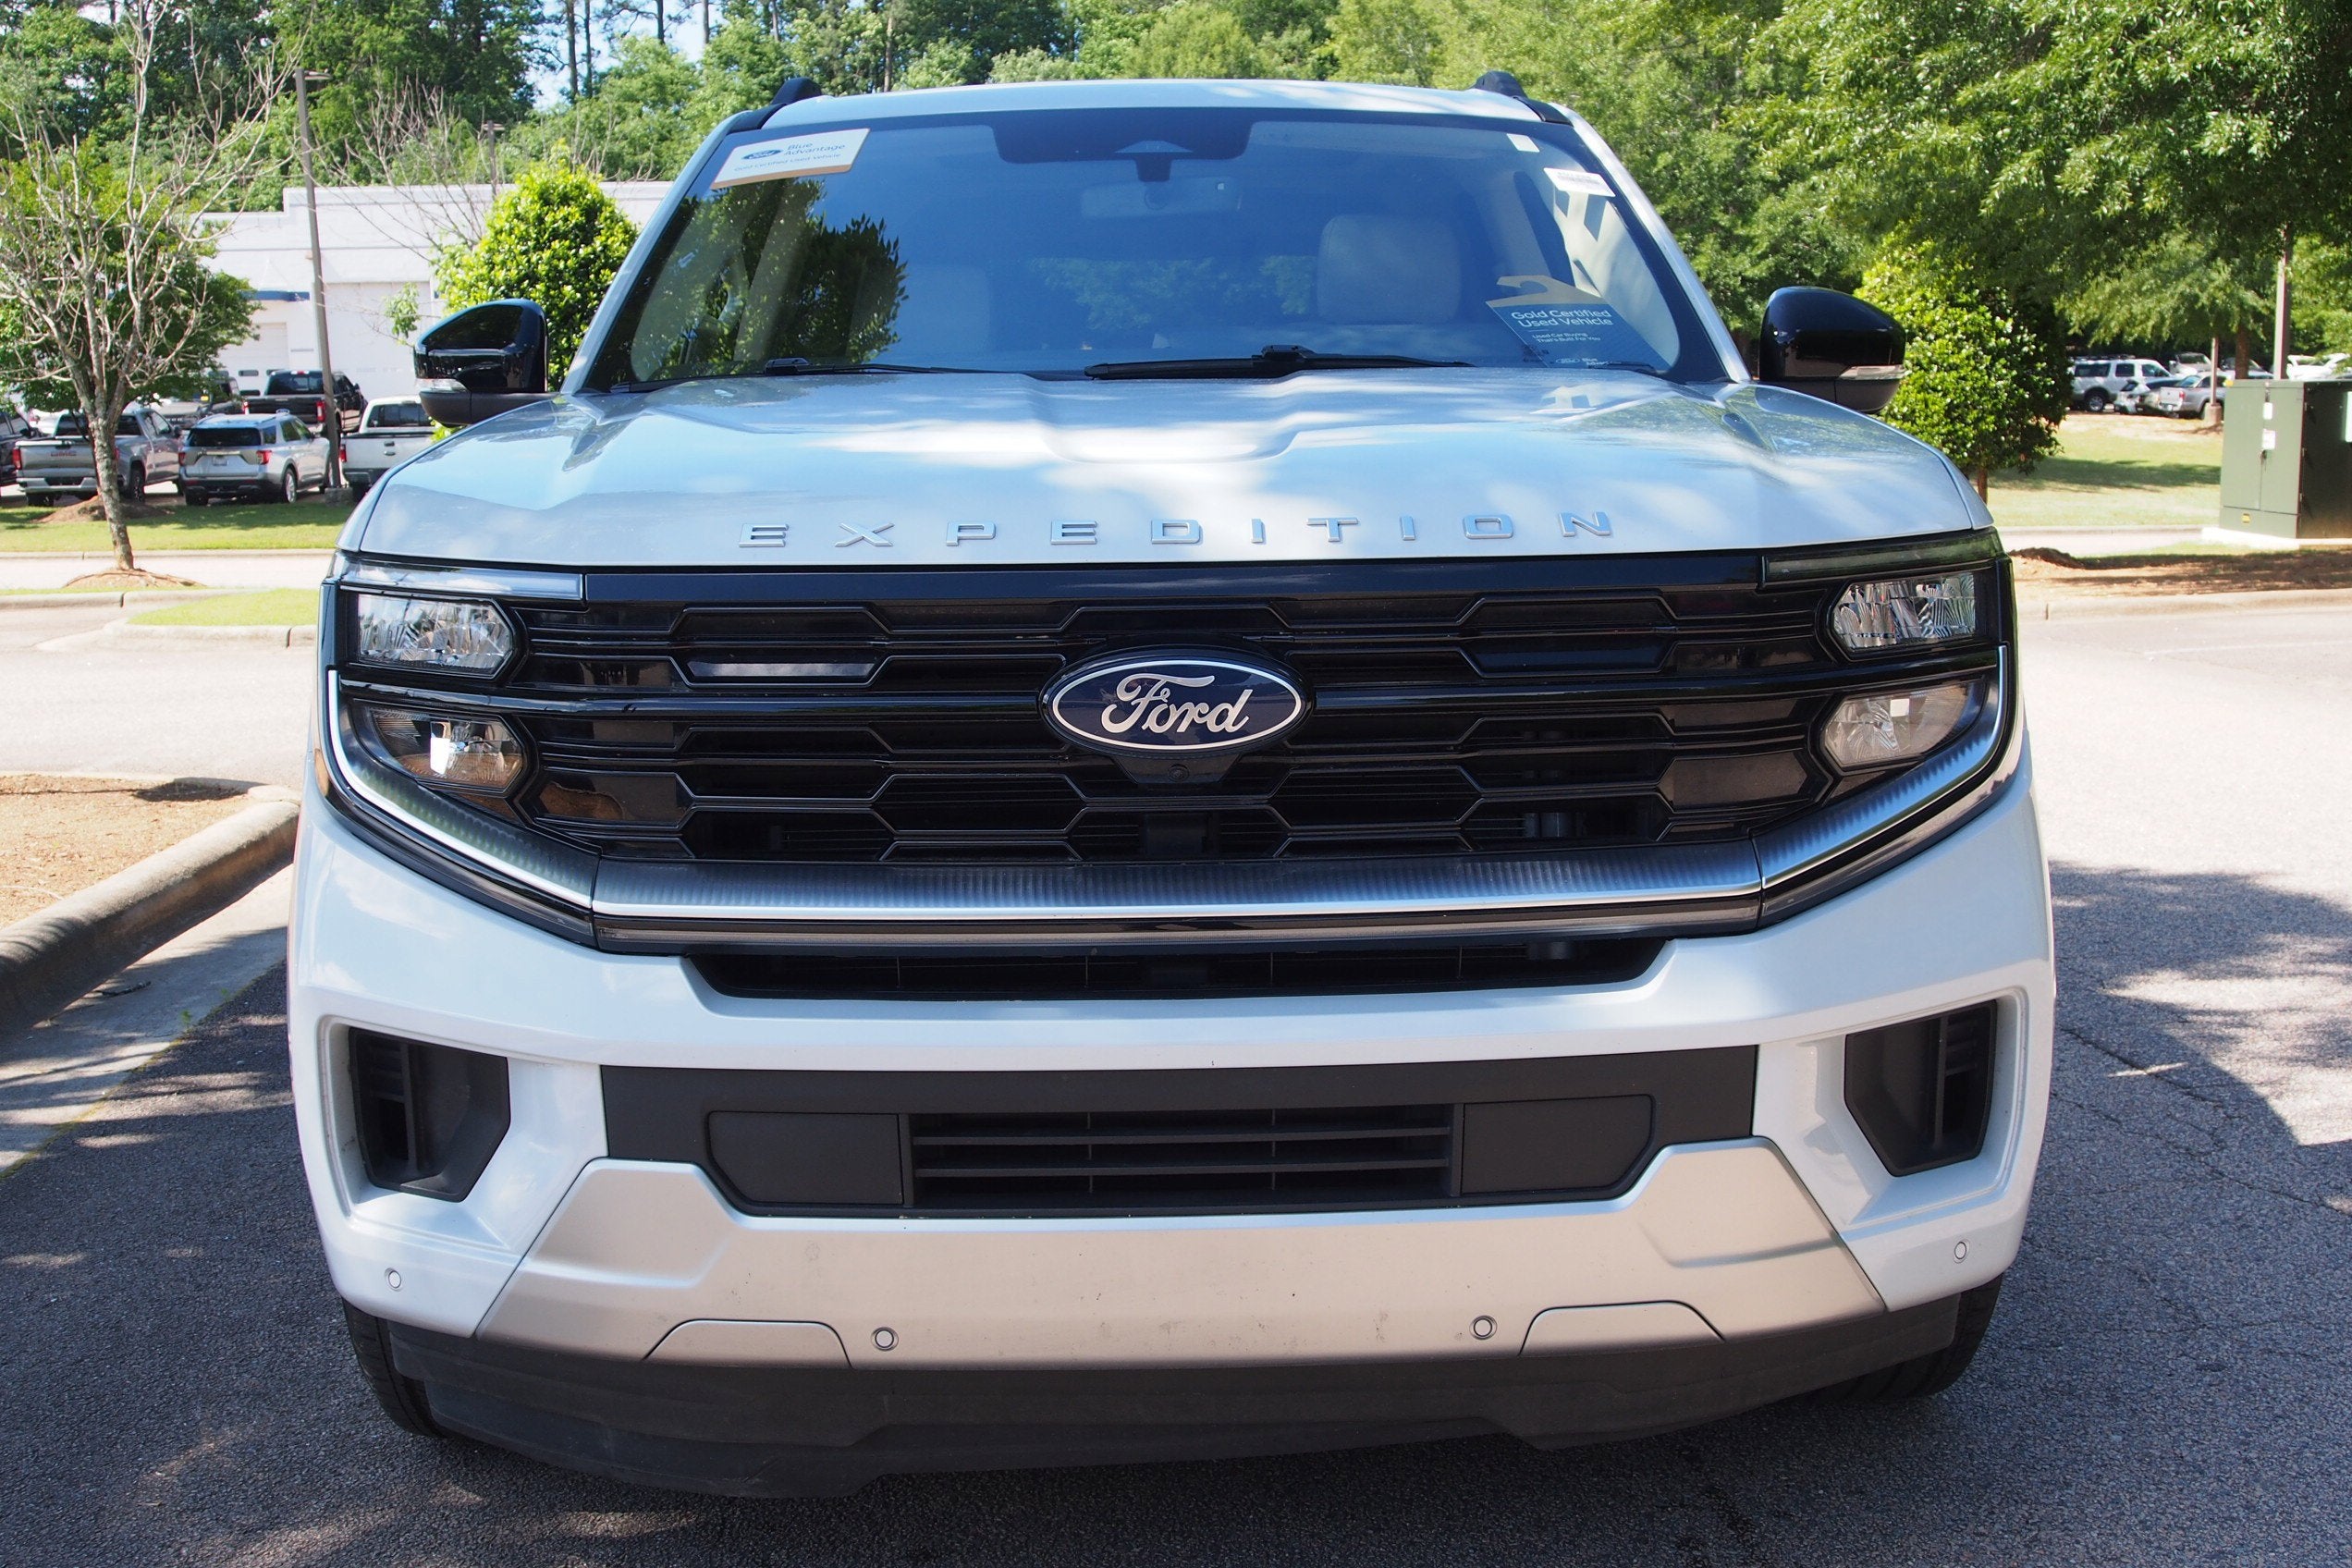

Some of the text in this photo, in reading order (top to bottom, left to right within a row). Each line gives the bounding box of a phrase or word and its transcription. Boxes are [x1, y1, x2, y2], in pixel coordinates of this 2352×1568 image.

[784, 144, 846, 156] Advantage
[787, 142, 813, 151] Blue
[1511, 309, 1612, 320] Gold Certified
[1517, 317, 1613, 327] Used Vehicle
[739, 511, 1611, 547] EXPEDITION
[1101, 673, 1253, 733] Ford
